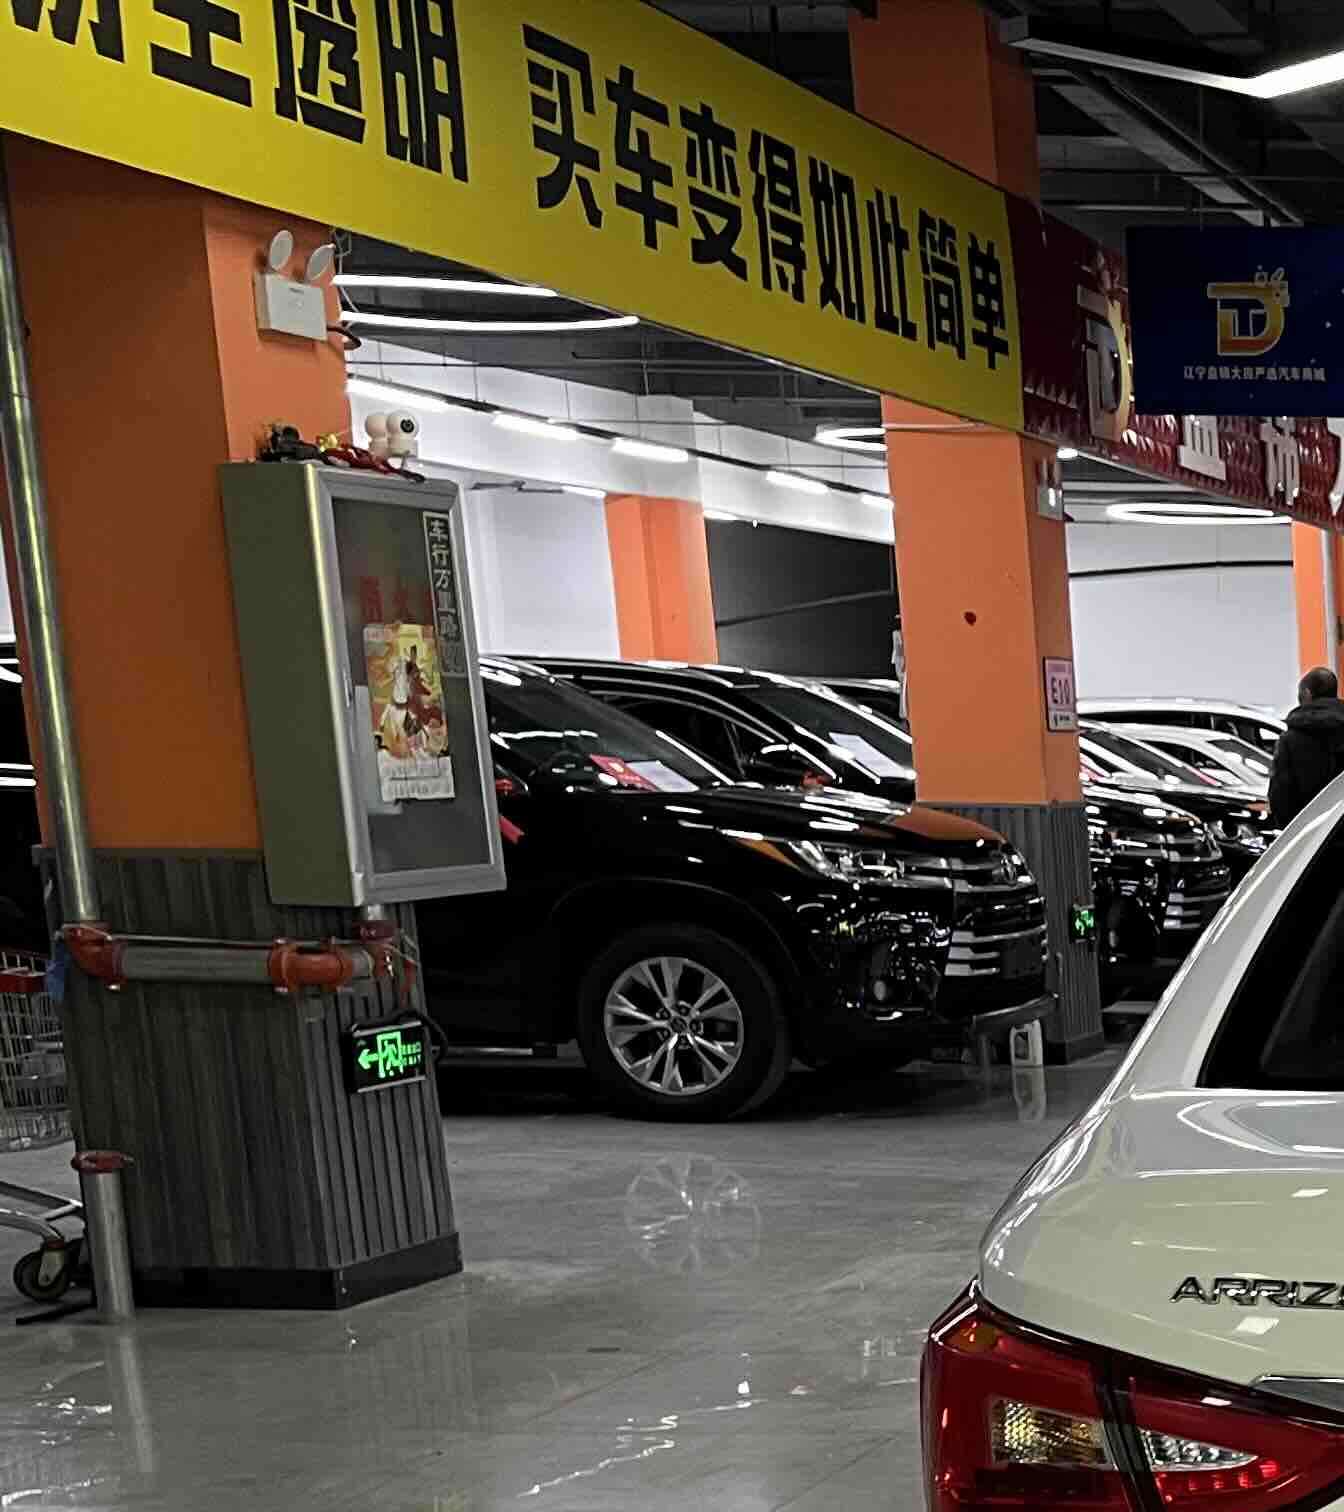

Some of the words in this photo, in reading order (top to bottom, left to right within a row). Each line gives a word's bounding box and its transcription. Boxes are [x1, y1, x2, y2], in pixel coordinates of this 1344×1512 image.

[522, 23, 1011, 371] 买车变得如此简单
